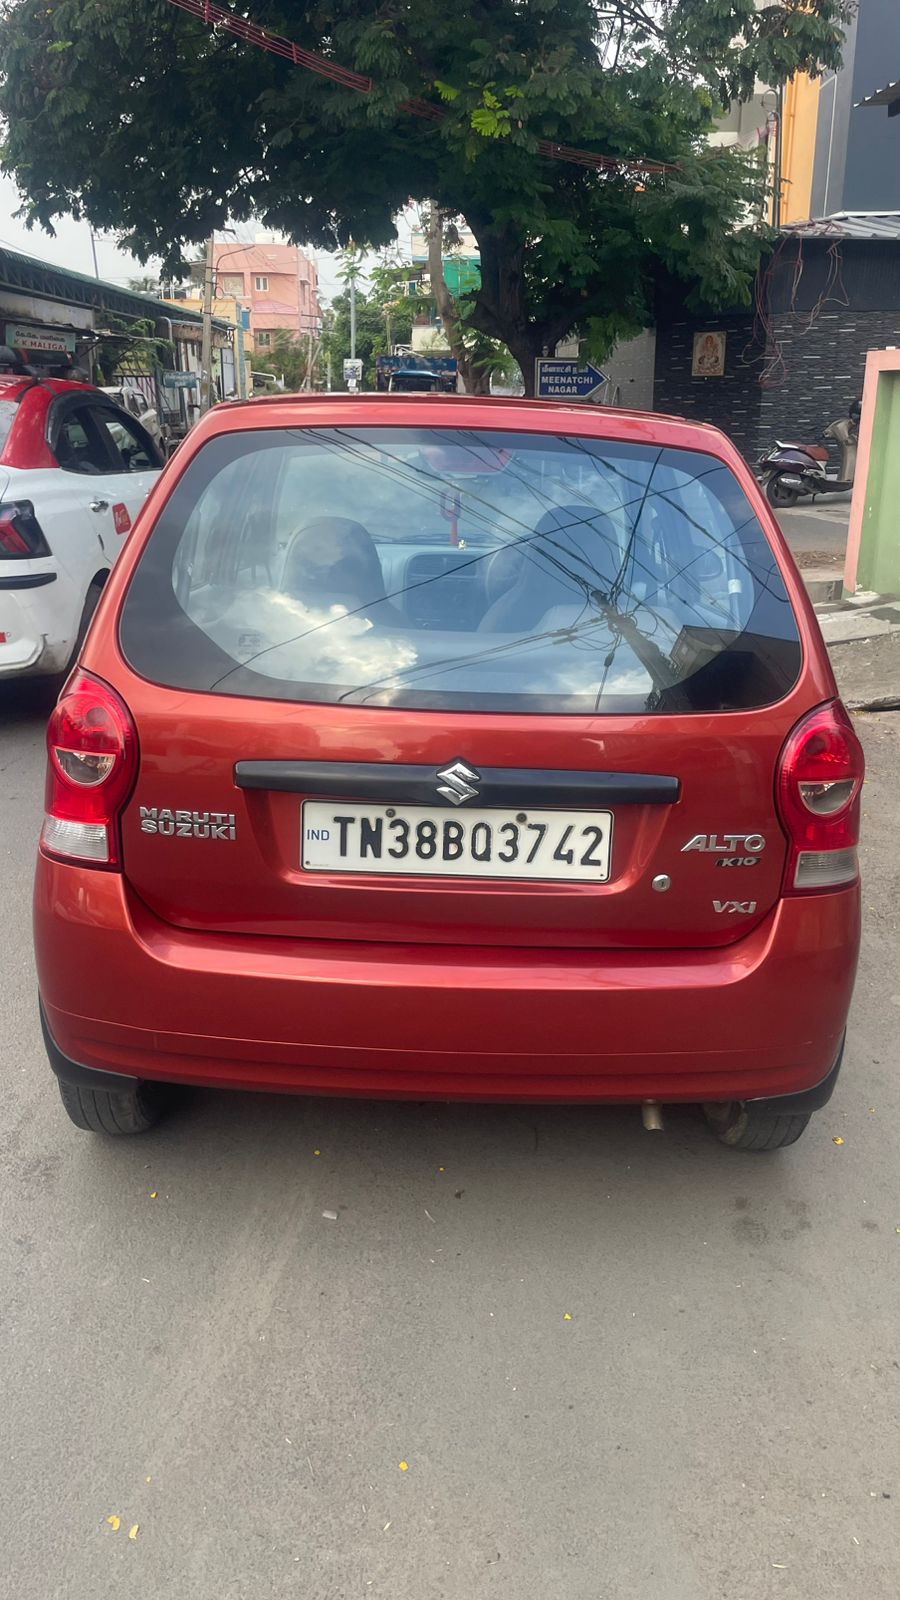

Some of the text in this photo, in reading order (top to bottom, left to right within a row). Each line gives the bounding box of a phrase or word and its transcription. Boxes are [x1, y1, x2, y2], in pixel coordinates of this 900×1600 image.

[541, 375, 593, 384] MEENATCHI
[548, 385, 578, 394] NAGAR
[139, 806, 236, 826] MARUTI
[140, 819, 236, 841] SUZUKI
[306, 815, 603, 867] IND TN38BQ3742
[680, 834, 766, 853] ALTO
[721, 857, 758, 867] K10
